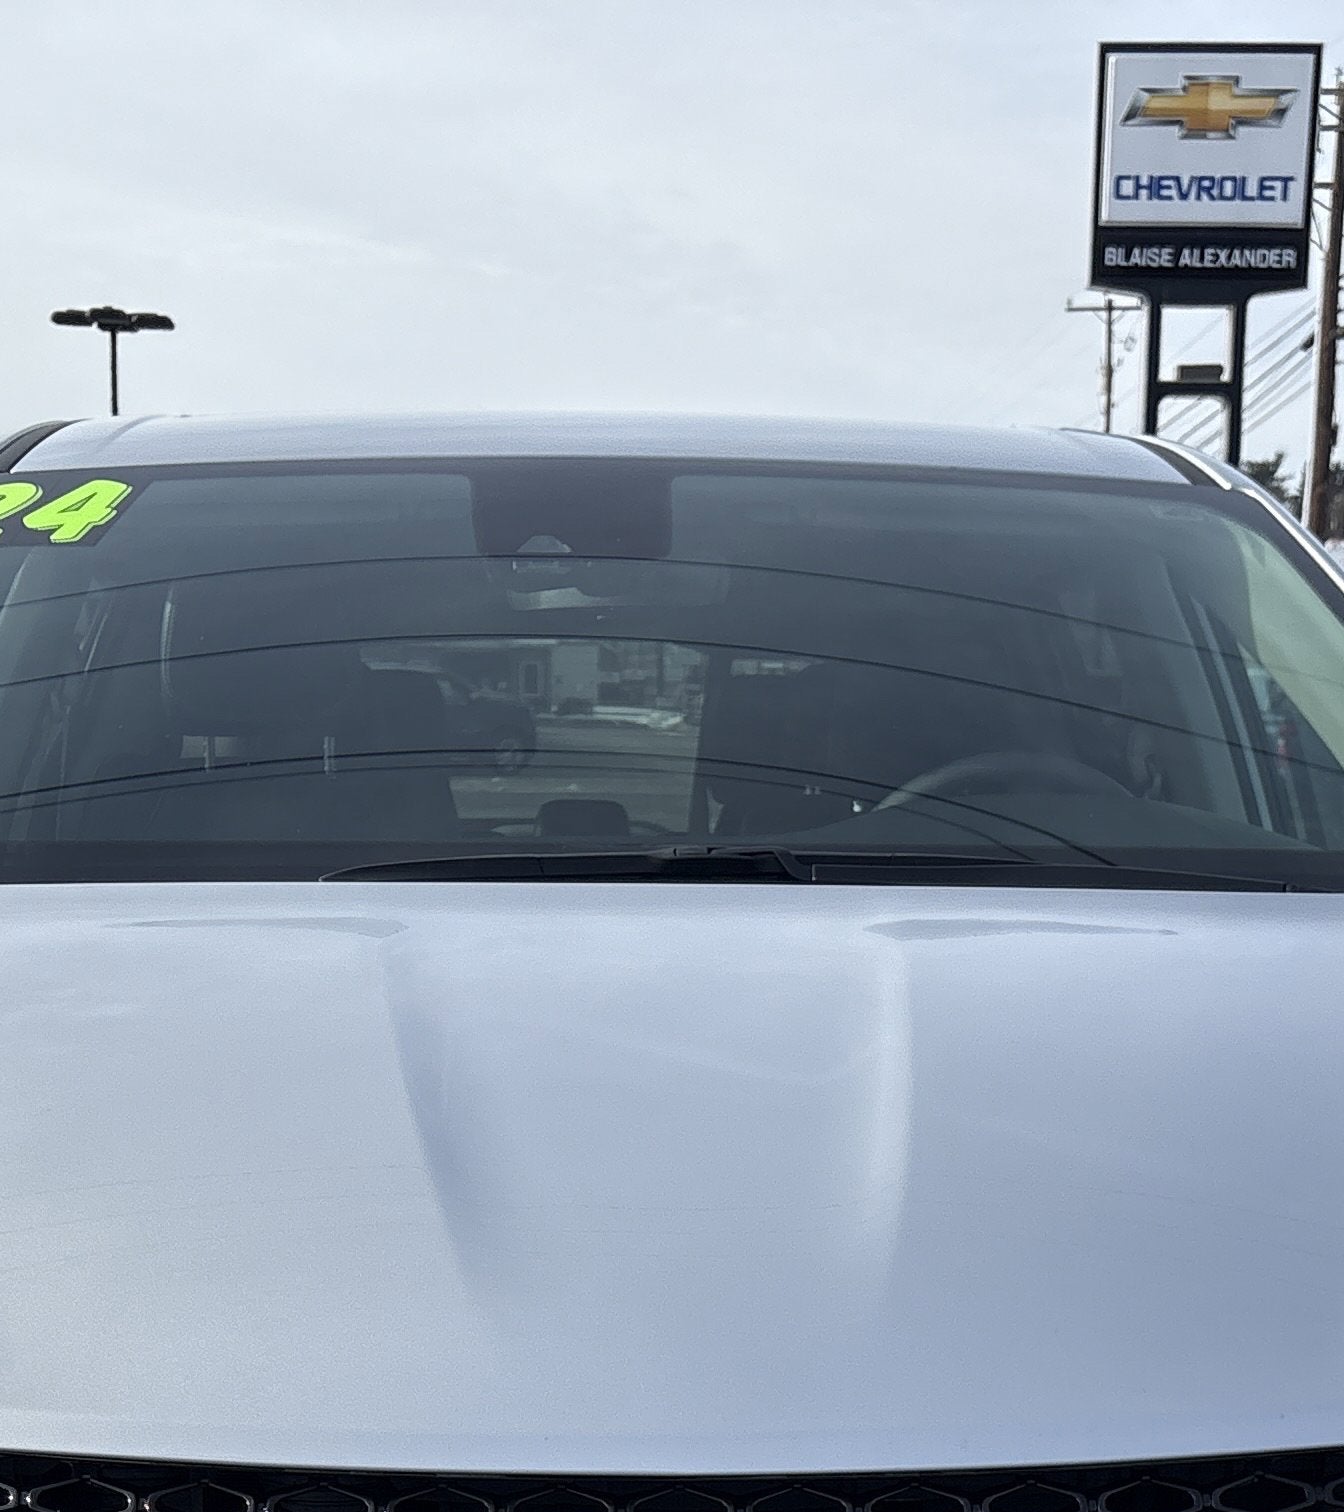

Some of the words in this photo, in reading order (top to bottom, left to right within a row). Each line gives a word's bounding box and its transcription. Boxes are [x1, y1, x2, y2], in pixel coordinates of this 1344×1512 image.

[1114, 176, 1297, 202] CHEVROLET
[1104, 246, 1175, 267] BLAISE
[1178, 247, 1297, 269] ALEXANDER
